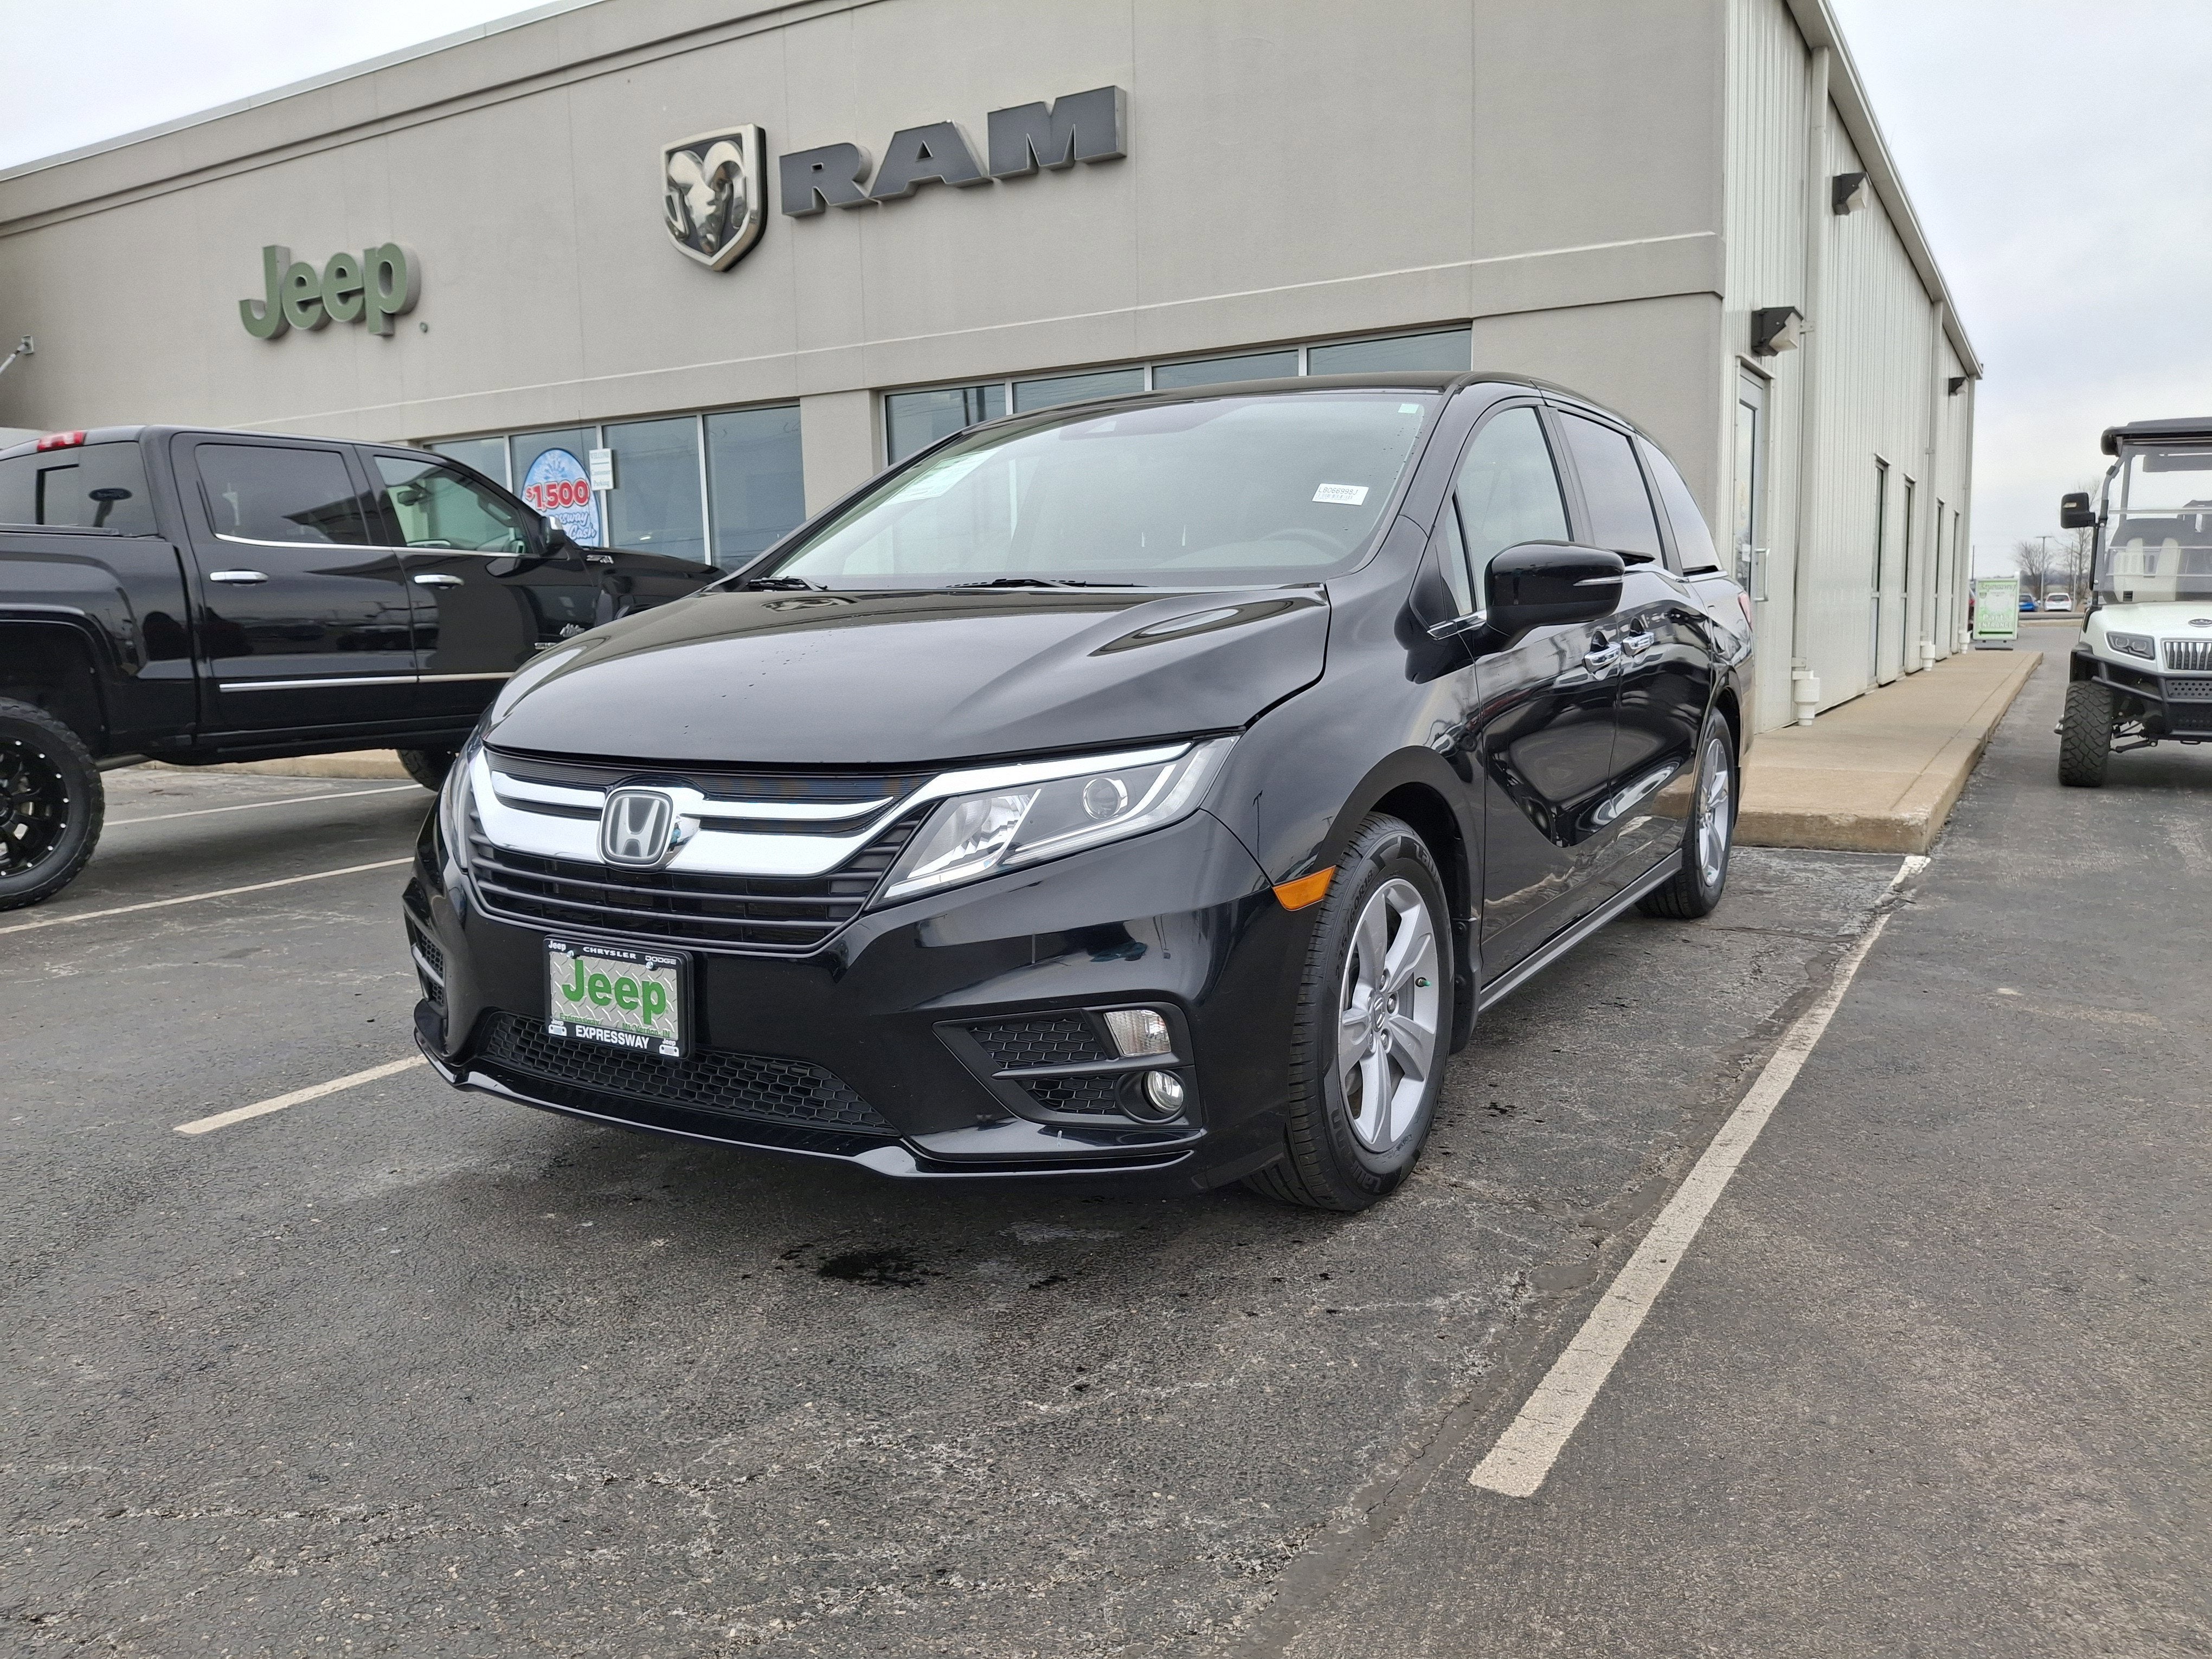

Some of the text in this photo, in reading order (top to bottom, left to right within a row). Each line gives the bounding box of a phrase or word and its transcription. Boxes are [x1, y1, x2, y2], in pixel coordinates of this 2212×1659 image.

[779, 86, 1127, 218] RAM
[239, 242, 421, 339] Jeep
[525, 478, 590, 512] $1,500
[568, 523, 596, 541] Cash
[548, 940, 677, 965] Jeep CHRYSLER DODGE
[562, 959, 666, 1025] Jeep
[551, 1018, 564, 1026] Jeep
[575, 1024, 650, 1049] EXPRESSWAY
[662, 1038, 676, 1047] Jeep
